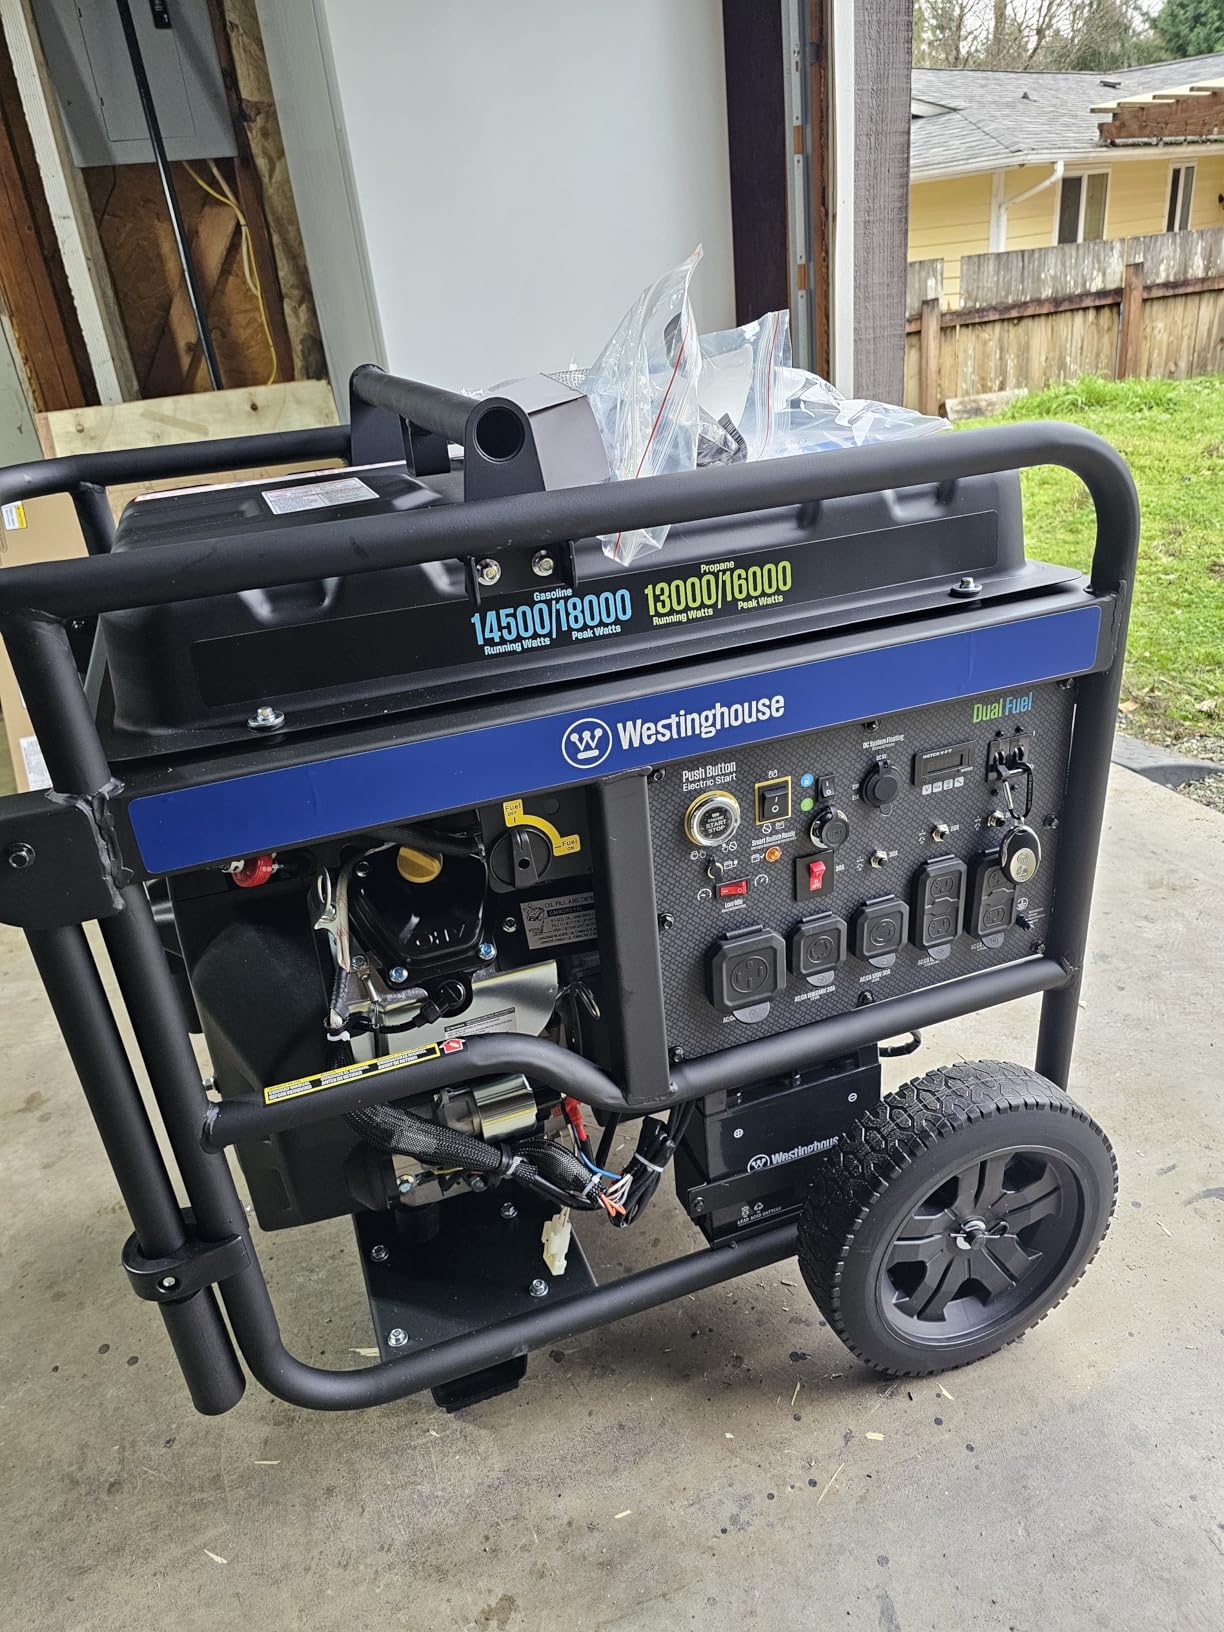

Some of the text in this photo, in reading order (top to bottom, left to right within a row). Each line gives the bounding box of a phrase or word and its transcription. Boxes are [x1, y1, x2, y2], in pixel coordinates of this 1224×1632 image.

[700, 561, 735, 574] Propane
[533, 587, 573, 602] Gasoline
[644, 560, 792, 616] 13000/16000
[737, 594, 784, 611] Peak Watts
[470, 588, 632, 646] 14500/18000
[652, 607, 714, 626] Running Watts
[571, 624, 622, 641] Peak Watts
[484, 636, 551, 656] Running Watts
[972, 691, 1034, 724] Dual Fuel
[616, 695, 785, 751] Westinghouse
[682, 761, 737, 783] Push Button
[683, 772, 737, 792] Electric Start
[504, 803, 521, 812] Fuel
[705, 818, 727, 829] START
[707, 825, 726, 834] STOP
[562, 839, 578, 847] Fuel
